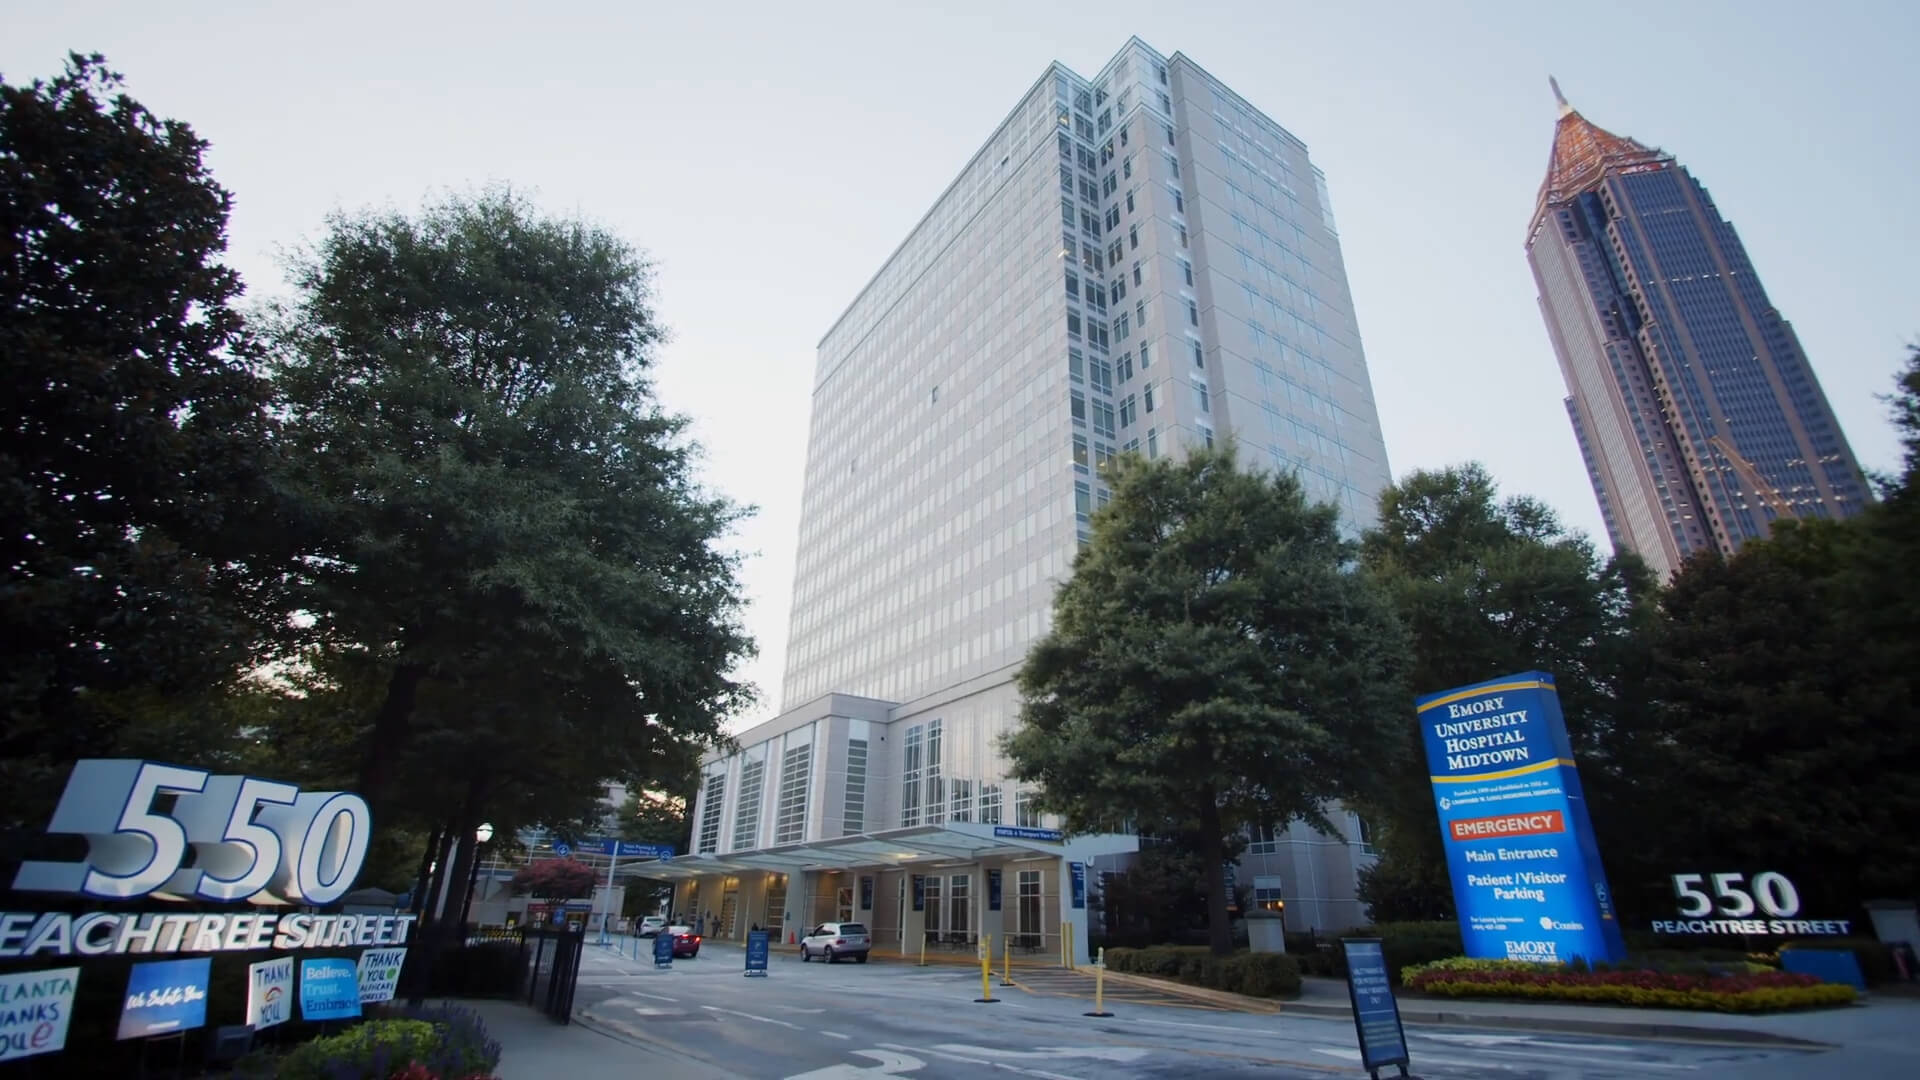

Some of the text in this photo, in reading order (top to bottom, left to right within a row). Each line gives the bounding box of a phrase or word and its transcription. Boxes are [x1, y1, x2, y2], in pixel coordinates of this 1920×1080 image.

[1448, 697, 1504, 719] EMORY
[1434, 710, 1528, 738] UNIVERSITY
[1446, 729, 1525, 753] HOSPITAL
[1447, 747, 1529, 770] MIDTOWN
[82, 760, 371, 906] 550
[1455, 815, 1552, 836] EMERGENCY
[1465, 848, 1558, 862] Main Entrance
[1467, 874, 1514, 887] Patient
[1520, 871, 1567, 884] Visitor
[1493, 887, 1545, 902] Parking
[1672, 872, 1799, 918] 550
[0, 912, 416, 954] EACHTREE STREET
[1652, 920, 1849, 935] PEACHTREE STREET
[1504, 940, 1557, 955] EMORY
[365, 951, 402, 968] THANK
[256, 964, 290, 987] THANK
[367, 969, 386, 982] YOU
[261, 1001, 282, 1023] YOU
